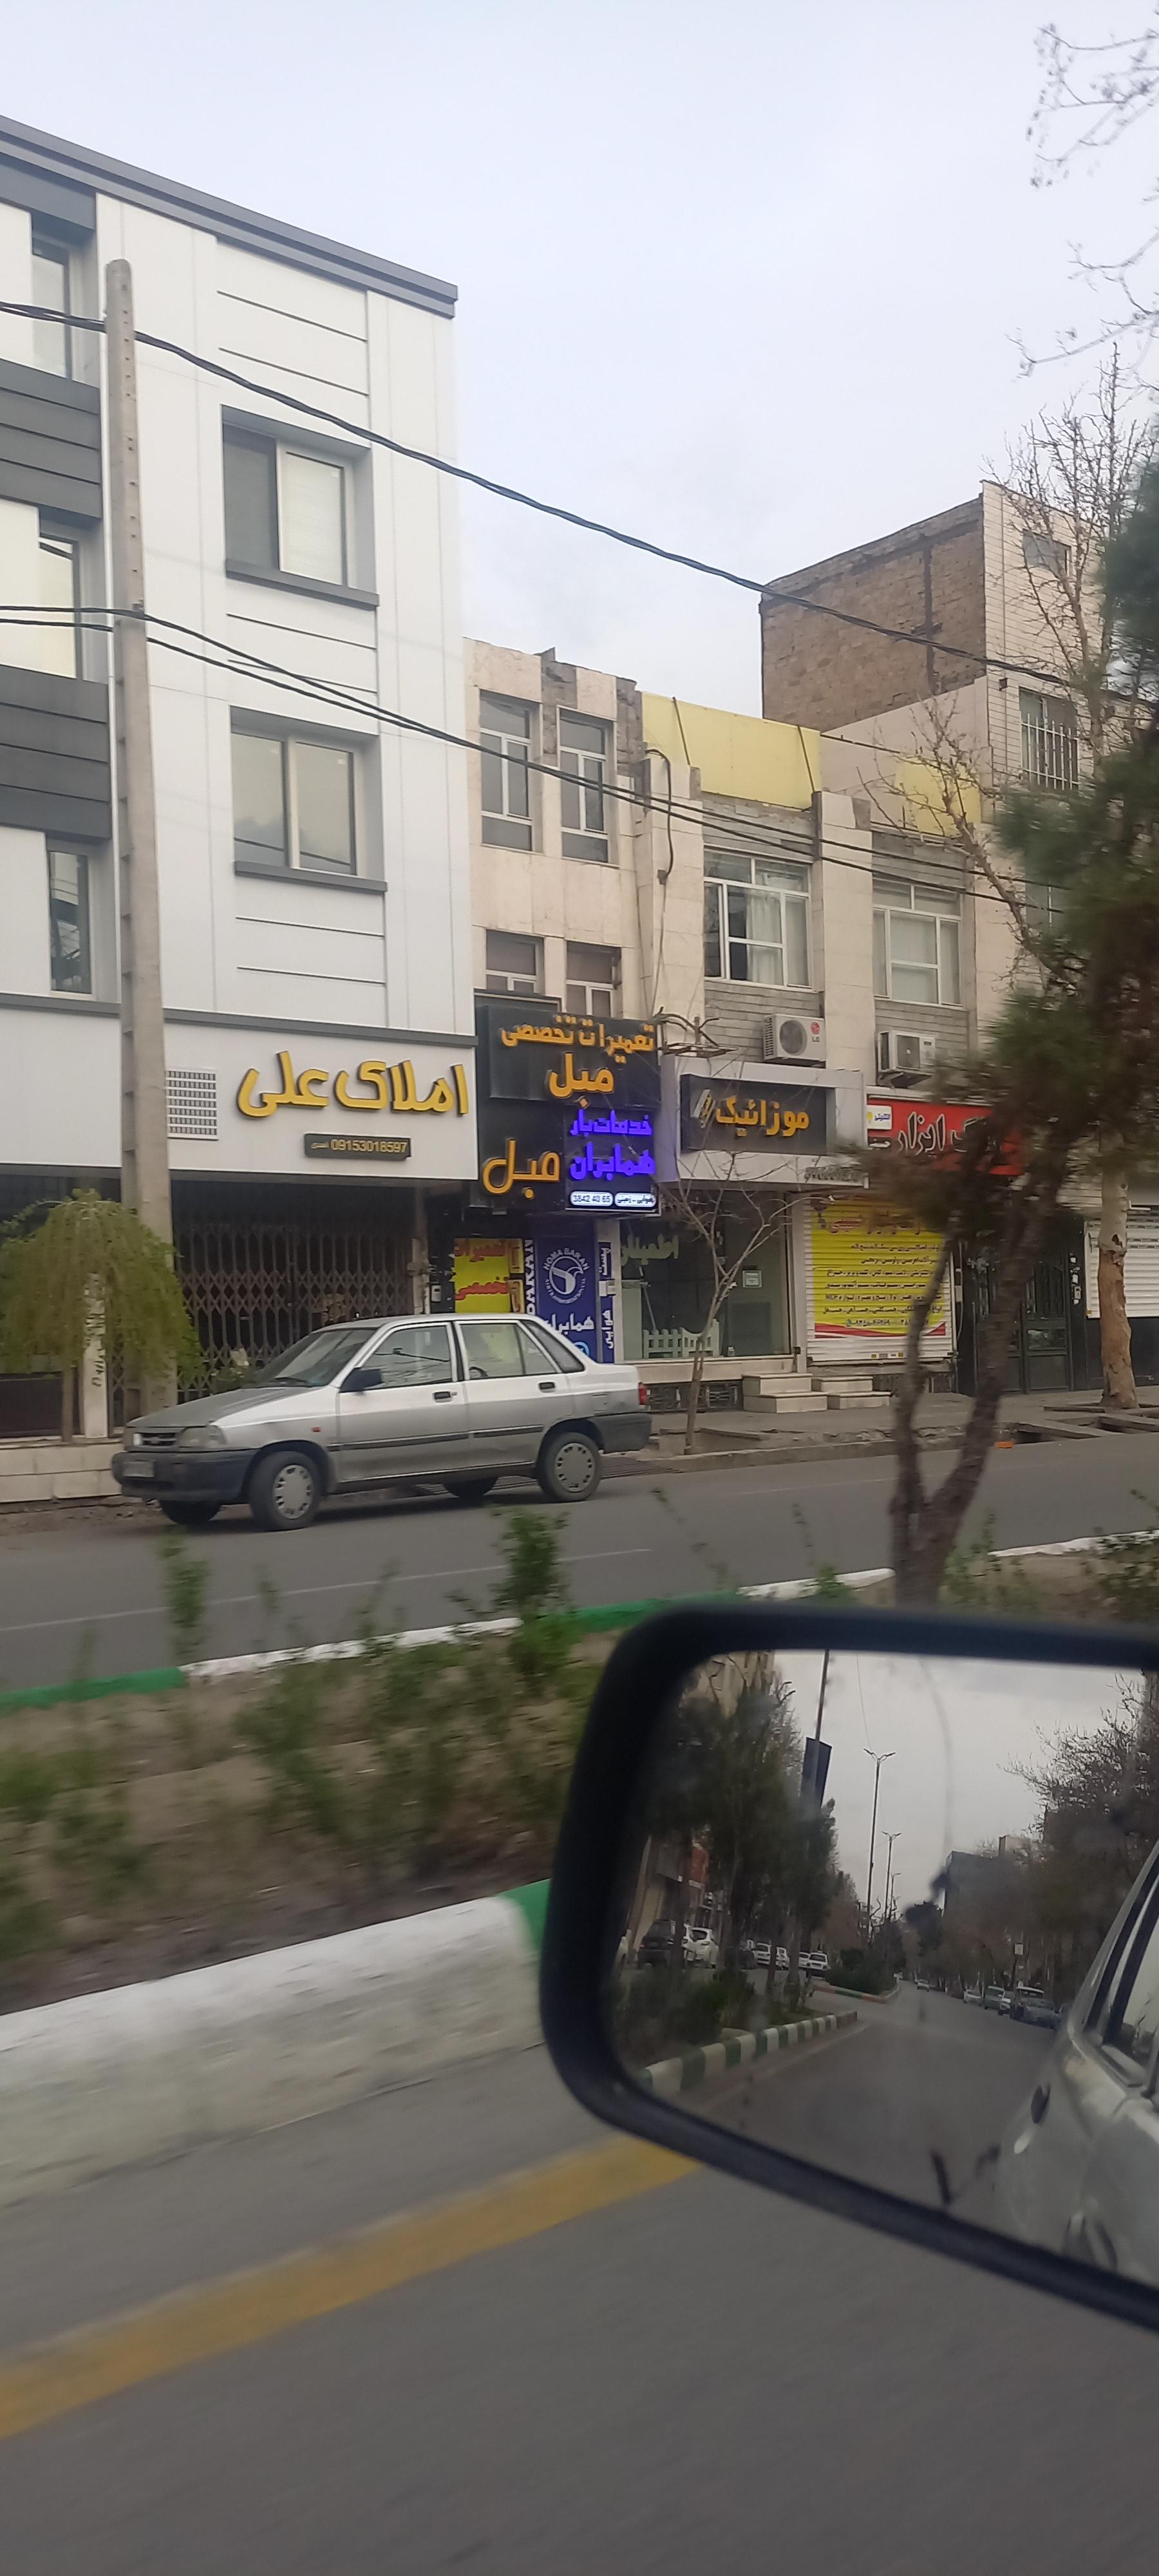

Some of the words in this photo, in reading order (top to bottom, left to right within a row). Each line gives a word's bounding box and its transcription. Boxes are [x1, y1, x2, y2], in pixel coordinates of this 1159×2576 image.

[500, 1015, 574, 1046] تخصصی
[580, 1018, 654, 1064] تعمیرات
[236, 1050, 330, 1118] علی
[334, 1059, 469, 1116] املاک
[549, 1051, 615, 1109] مبل
[570, 1108, 592, 1138] بار
[594, 1109, 652, 1135] خدمات
[330, 1139, 408, 1153] 09153018597
[570, 1141, 655, 1180] همابران
[483, 1139, 560, 1198] مبل
